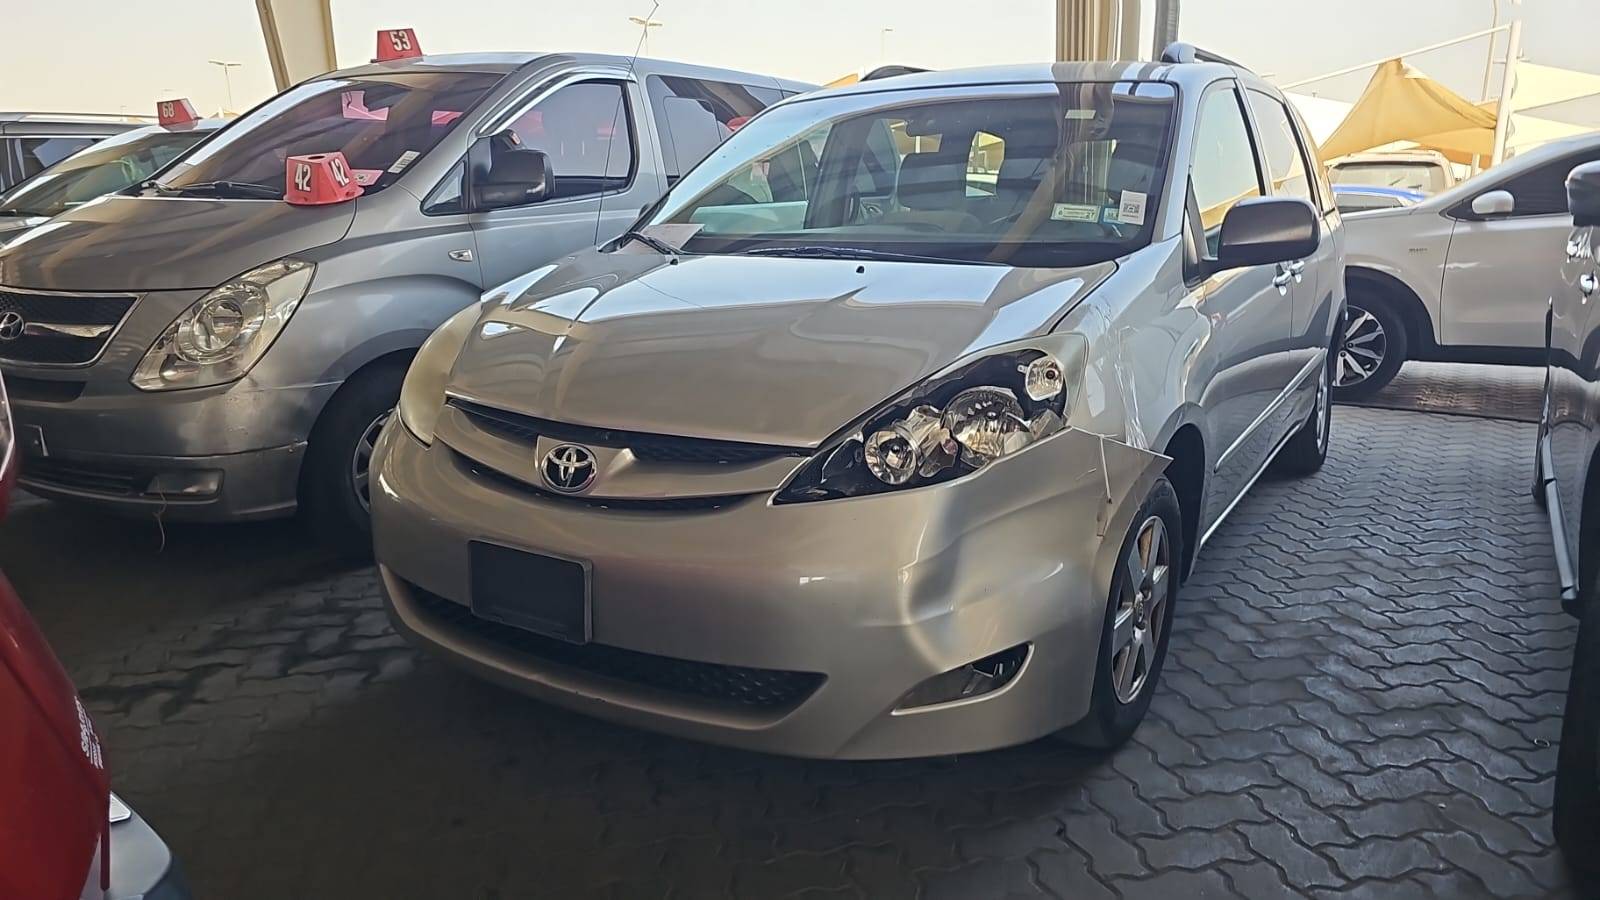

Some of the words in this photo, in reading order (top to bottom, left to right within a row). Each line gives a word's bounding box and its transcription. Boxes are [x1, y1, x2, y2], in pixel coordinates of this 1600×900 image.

[390, 31, 411, 50] 53
[295, 163, 311, 192] 42
[331, 159, 350, 187] 42
